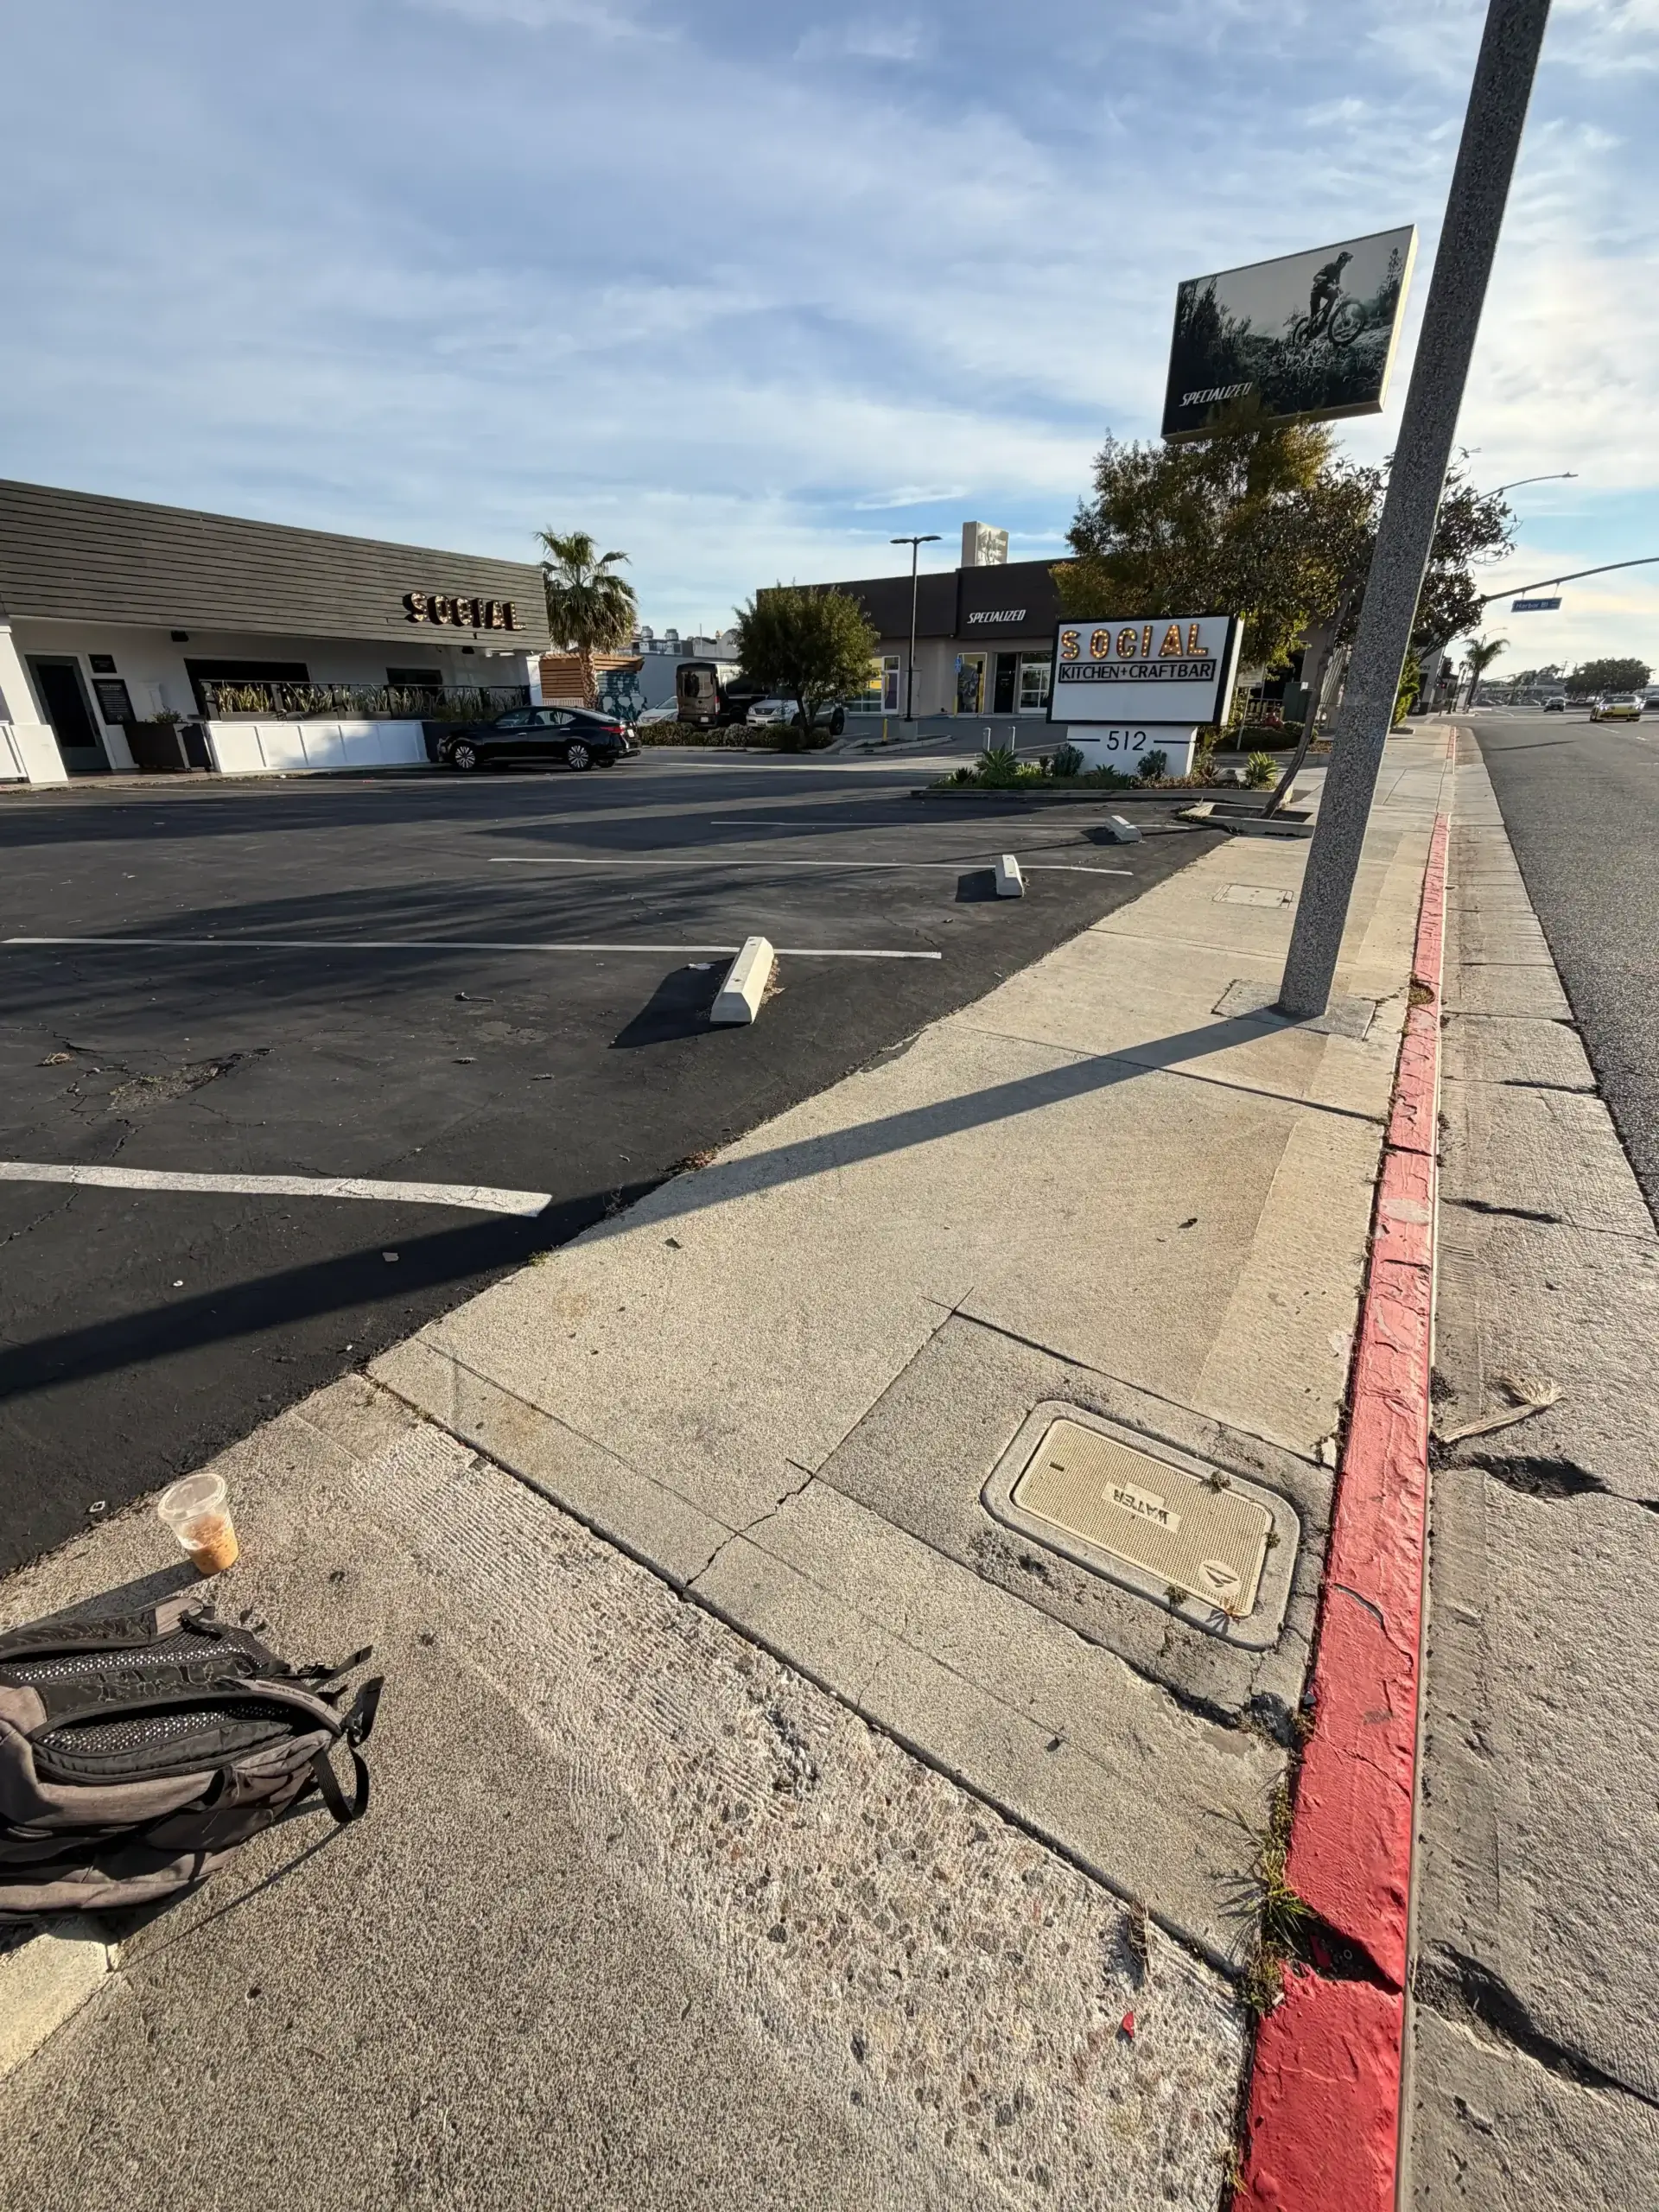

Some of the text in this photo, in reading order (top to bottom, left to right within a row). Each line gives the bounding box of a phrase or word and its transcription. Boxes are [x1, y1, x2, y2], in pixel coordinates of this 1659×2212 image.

[1179, 382, 1253, 407] SPECIALIZED
[403, 591, 526, 631] SOCIAL
[967, 609, 1027, 624] SPECIALIZED
[1060, 623, 1209, 660] SOCIAL
[1106, 731, 1147, 751] 512
[1113, 1489, 1170, 1524] WATER
